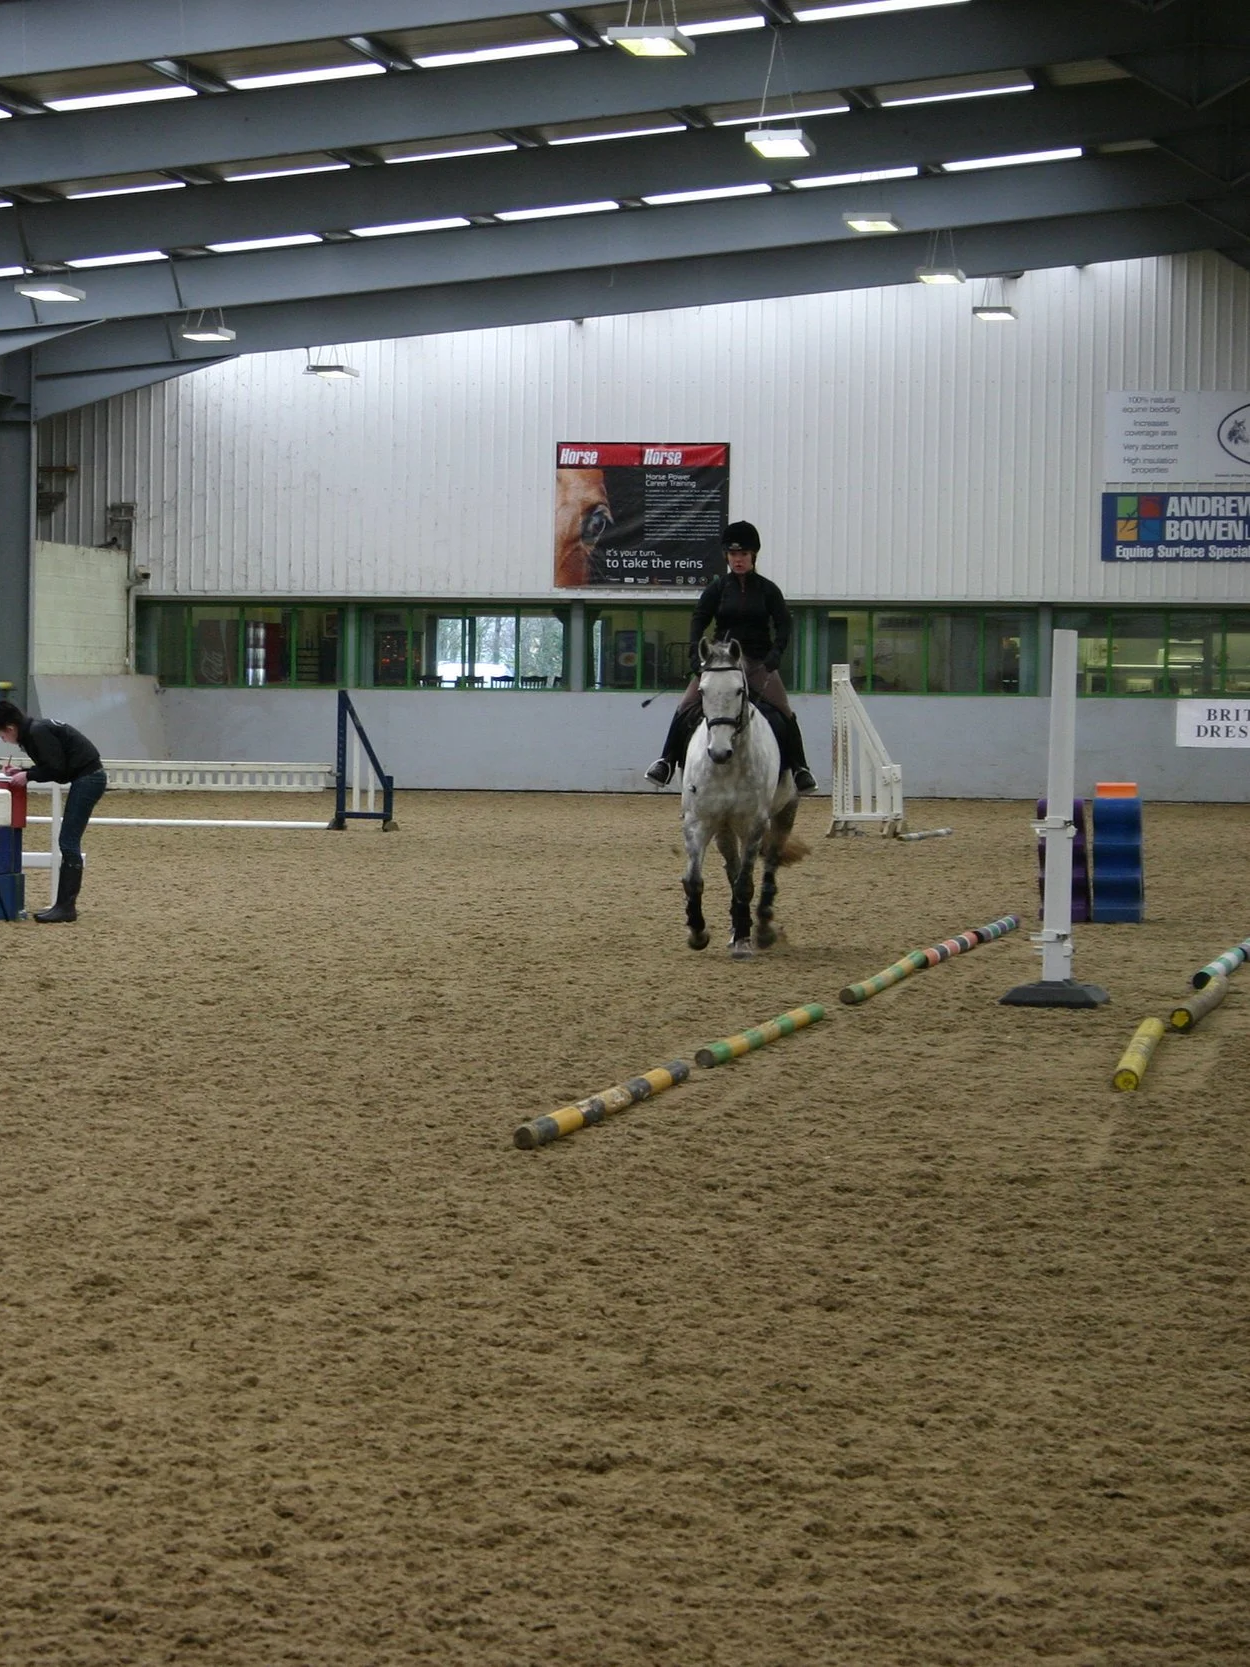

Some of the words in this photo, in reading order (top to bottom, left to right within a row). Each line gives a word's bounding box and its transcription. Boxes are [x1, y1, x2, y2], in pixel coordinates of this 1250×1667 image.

[1150, 405, 1180, 415] bedding
[1123, 443, 1139, 451] Very
[560, 448, 598, 465] Horse
[643, 448, 682, 466] Horse
[1123, 456, 1141, 465] High
[645, 473, 667, 481] Horse
[668, 473, 691, 481] Power
[645, 480, 669, 488] Career
[670, 480, 697, 489] Training
[1165, 520, 1244, 541] BOWEN
[620, 550, 638, 558] your
[1115, 545, 1154, 560] Equine
[1157, 545, 1205, 558] Surface
[605, 558, 619, 569] to
[622, 557, 648, 569] take
[651, 557, 671, 569] the
[675, 558, 703, 569] reins
[1195, 724, 1248, 738] DRES
